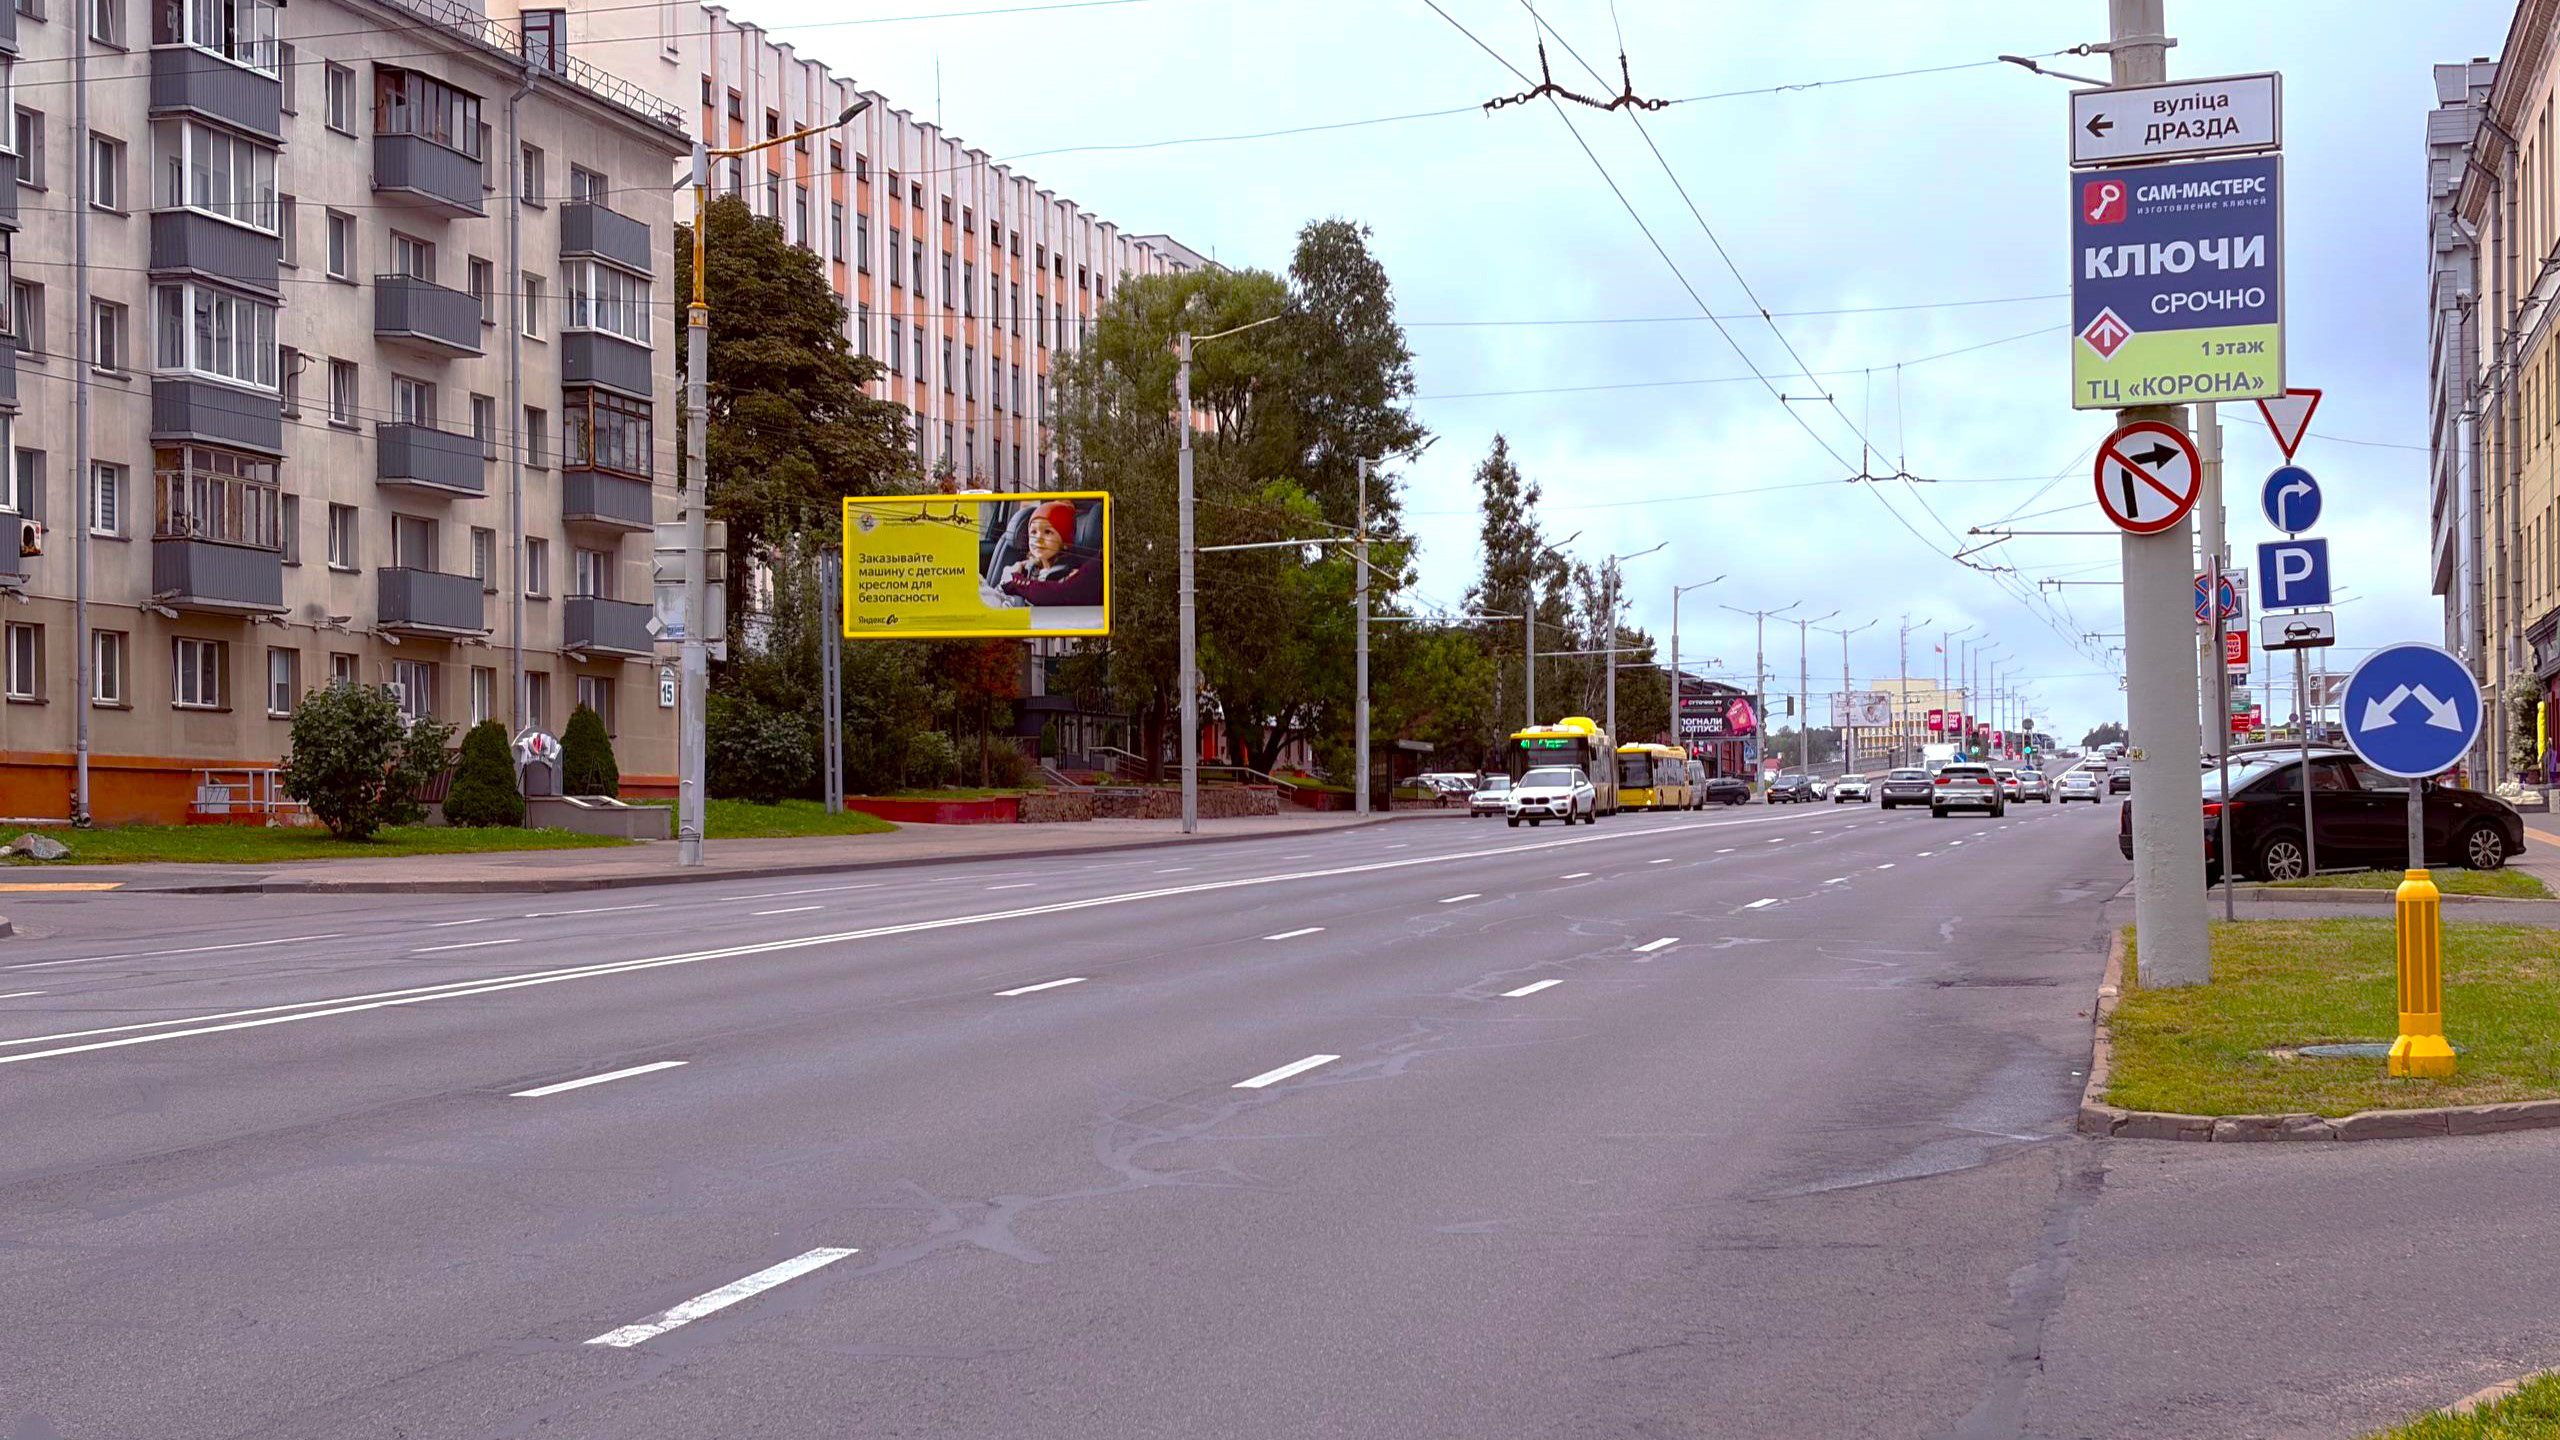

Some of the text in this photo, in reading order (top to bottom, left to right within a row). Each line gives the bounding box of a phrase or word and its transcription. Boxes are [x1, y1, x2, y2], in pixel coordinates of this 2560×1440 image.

[2153, 92, 2229, 116] вуліца
[2144, 116, 2240, 145] ДРАЗДА
[2136, 177, 2266, 202] САМ-МАСТЕРС
[2137, 197, 2267, 215] изготовление ключей
[2151, 287, 2266, 314] СРОЧНО
[2201, 340, 2265, 356] 1 этаж
[2086, 371, 2265, 402] ТЦ «КОРОНА»
[858, 553, 934, 564] Заказывайте
[859, 567, 966, 578] машину с детским
[859, 581, 933, 591] креслом для
[858, 592, 940, 603] безопасности
[858, 615, 886, 625] Яндекс
[662, 683, 673, 703] 15
